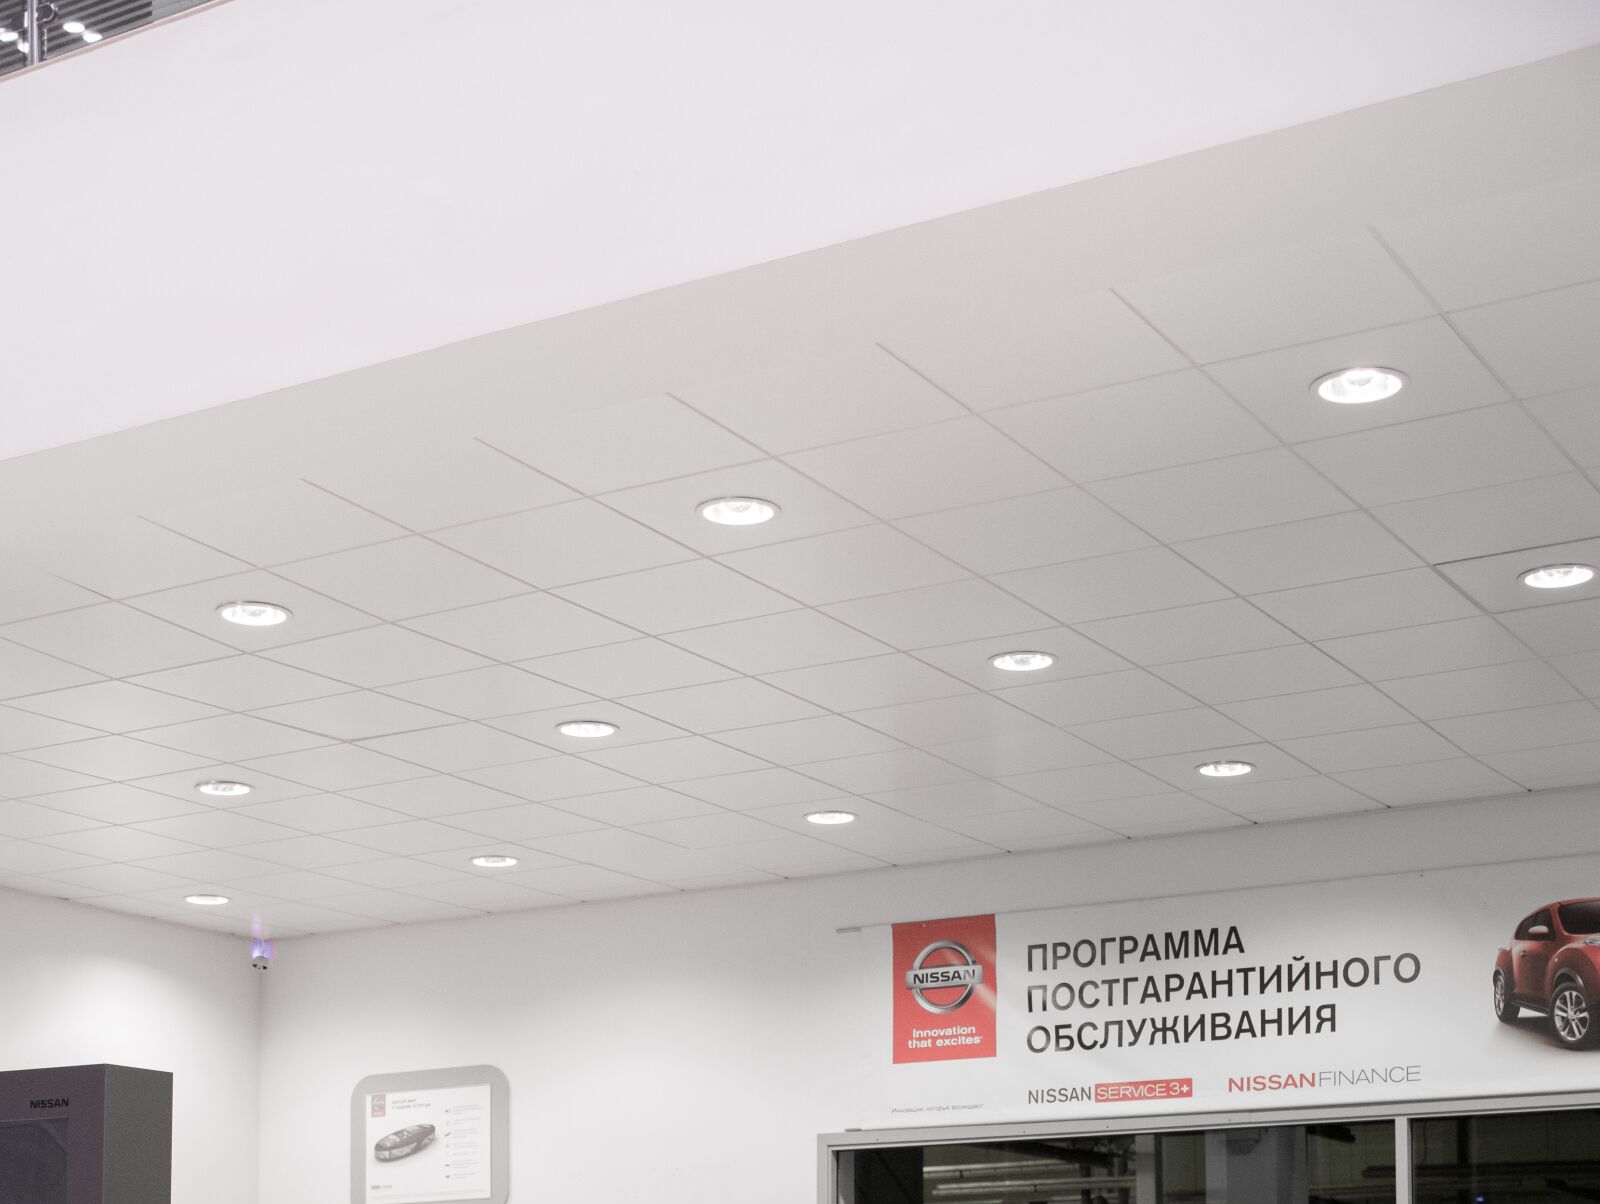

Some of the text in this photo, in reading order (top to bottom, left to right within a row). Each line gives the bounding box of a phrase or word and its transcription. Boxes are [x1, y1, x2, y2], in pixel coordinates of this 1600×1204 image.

[1027, 925, 1245, 972] ПРОГРАММА
[913, 969, 976, 985] NISSAN
[1027, 952, 1421, 1013] ПОСТГАРАНТИЙНОГО
[912, 1025, 976, 1038] Innovation
[1026, 1003, 1336, 1054] ОБСЛУЖИВАНИЯ
[907, 1038, 932, 1049] that
[1028, 1082, 1190, 1104] NISSAN SERVICE 3+
[30, 1098, 70, 1109] NISSAN
